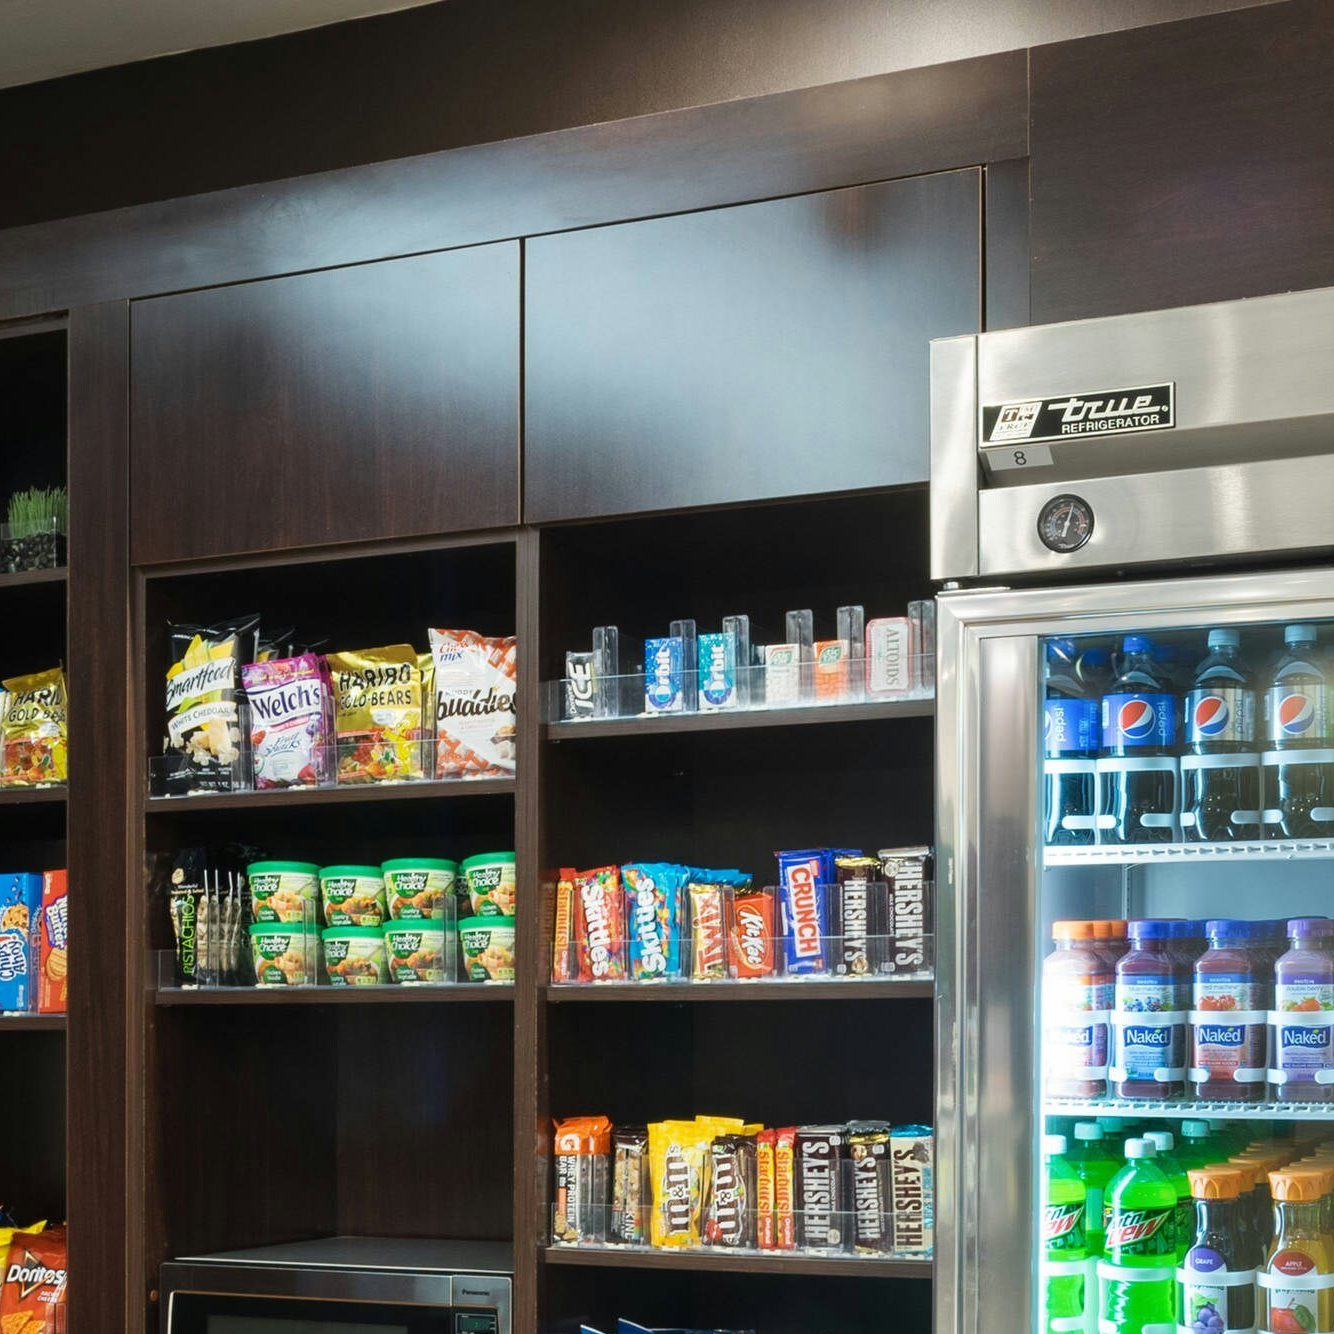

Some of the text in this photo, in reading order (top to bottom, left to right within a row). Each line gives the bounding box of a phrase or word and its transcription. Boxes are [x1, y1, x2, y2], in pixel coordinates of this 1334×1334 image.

[1062, 414, 1160, 434] REFRIGERATOR
[1013, 451, 1027, 466] 8
[885, 627, 900, 687] ALTOIDS
[166, 660, 236, 702] Smartfood
[340, 662, 412, 692] HARIBO
[252, 685, 320, 719] Welch's
[1157, 701, 1167, 738] pepsi
[1054, 707, 1066, 743] pepsi
[395, 881, 426, 891] Choice
[397, 872, 427, 884] Healthy
[581, 883, 612, 978] Skittles
[635, 877, 666, 974] Skittles
[791, 866, 819, 956] CRUNCH
[844, 879, 867, 962] HERSHEY'S
[894, 860, 924, 967] HERSHEY'S
[181, 894, 196, 976] PISTACHIOS
[1127, 1027, 1167, 1046] Naked
[1199, 1024, 1242, 1044] Naked
[1284, 1029, 1327, 1047] Naked
[567, 1155, 576, 1223] WHEY PROTEIN
[802, 1141, 831, 1239] HERSHEY'S
[854, 1157, 882, 1240] HERSHEY'S
[894, 1147, 924, 1246] HERSHEY'S
[6, 1264, 65, 1286] Doritos
